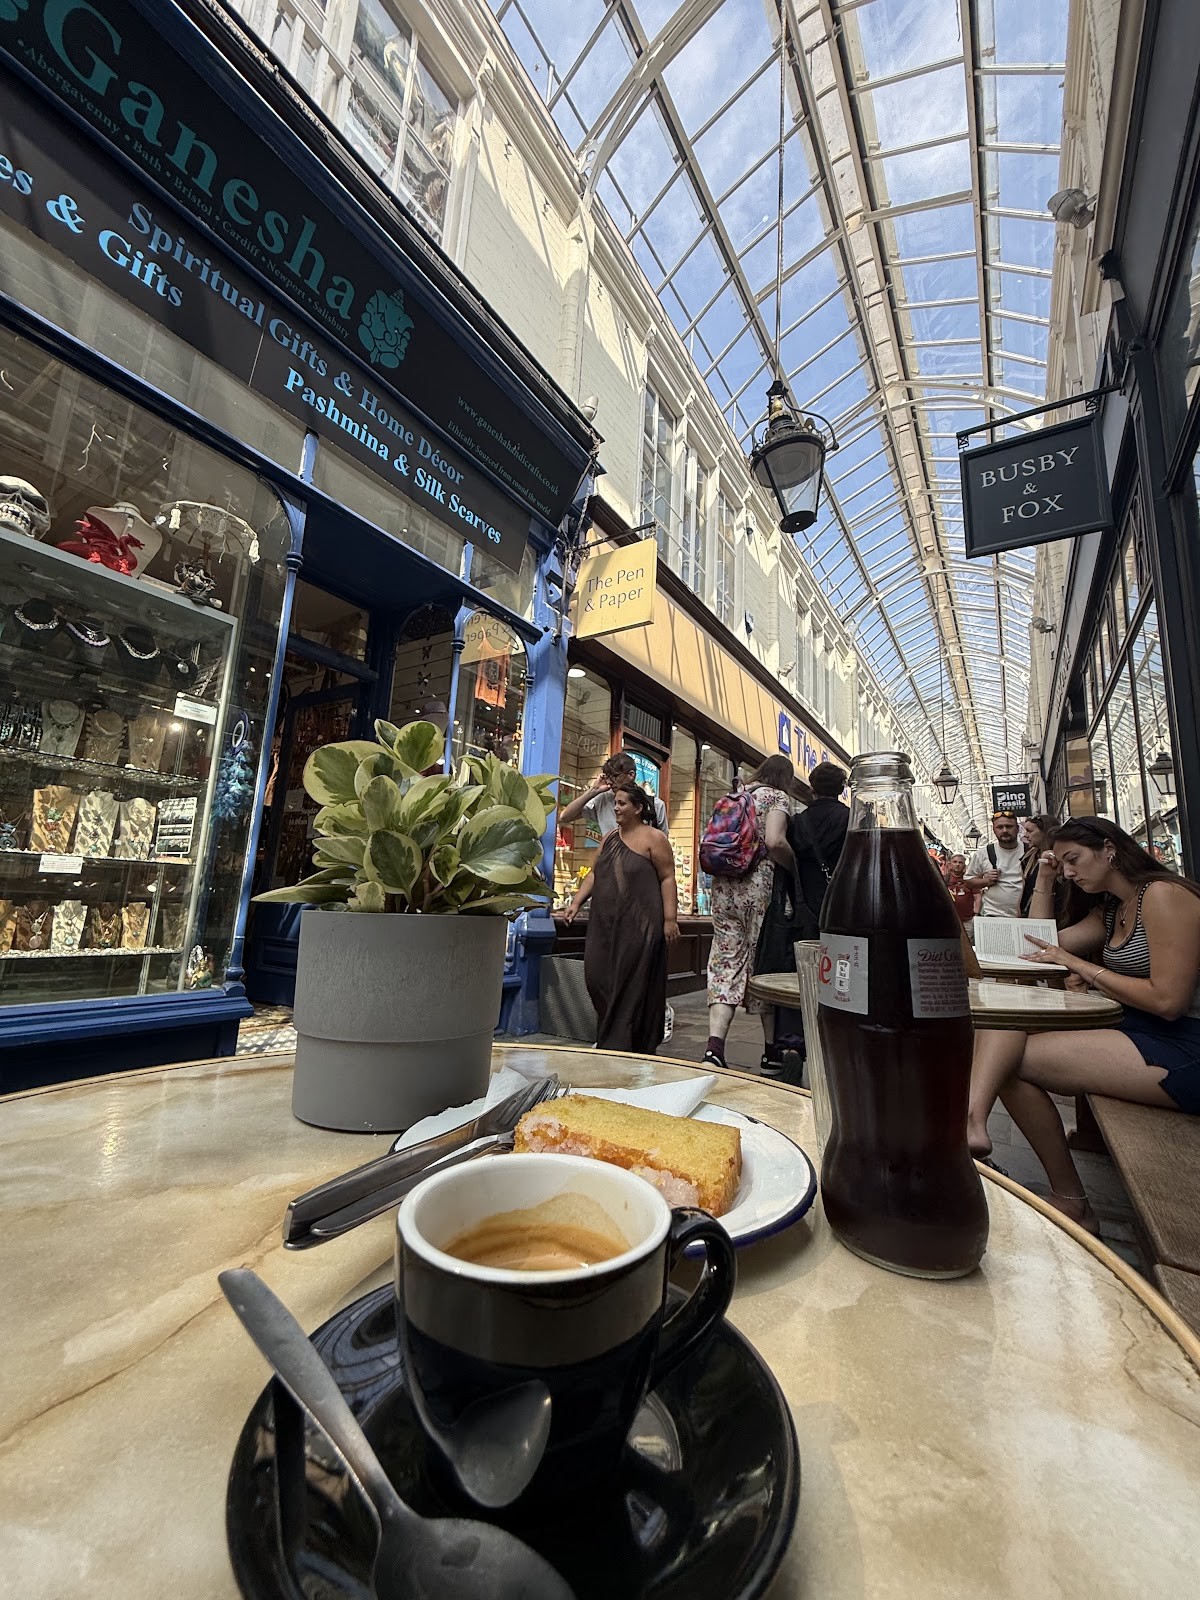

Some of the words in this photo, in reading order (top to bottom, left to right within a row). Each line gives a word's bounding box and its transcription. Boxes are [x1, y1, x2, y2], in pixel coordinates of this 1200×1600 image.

[43, 0, 356, 320] Ganesha
[24, 41, 121, 135] Abergavenny
[133, 137, 163, 174] Bath
[173, 174, 214, 217] Bristol
[222, 215, 261, 263] Cardiff
[266, 258, 307, 299] Newport
[312, 300, 350, 339] Salisbury
[46, 193, 85, 234] &
[98, 229, 183, 307] Gifts
[128, 201, 266, 327] Spiritual
[269, 318, 328, 377] Gifts
[333, 371, 354, 397] &
[358, 387, 414, 446] Home
[417, 436, 464, 485] Décor
[284, 366, 389, 461] Pashmina
[394, 453, 410, 477] &
[413, 467, 447, 505] Silk
[448, 493, 502, 545] Scarves
[447, 420, 475, 450] Ethically
[476, 445, 499, 471] Sourced
[498, 465, 512, 481] from
[511, 479, 529, 496] round
[528, 492, 537, 503] the
[536, 501, 551, 515] world
[980, 446, 1079, 488] BUSBY
[1002, 494, 1064, 524] FOX
[1022, 482, 1038, 495] &
[584, 597, 595, 613] &
[599, 587, 644, 609] Paper
[586, 576, 613, 593] The
[617, 567, 644, 585] Pen
[996, 792, 1026, 801] Dino
[917, 948, 943, 962] Diet
